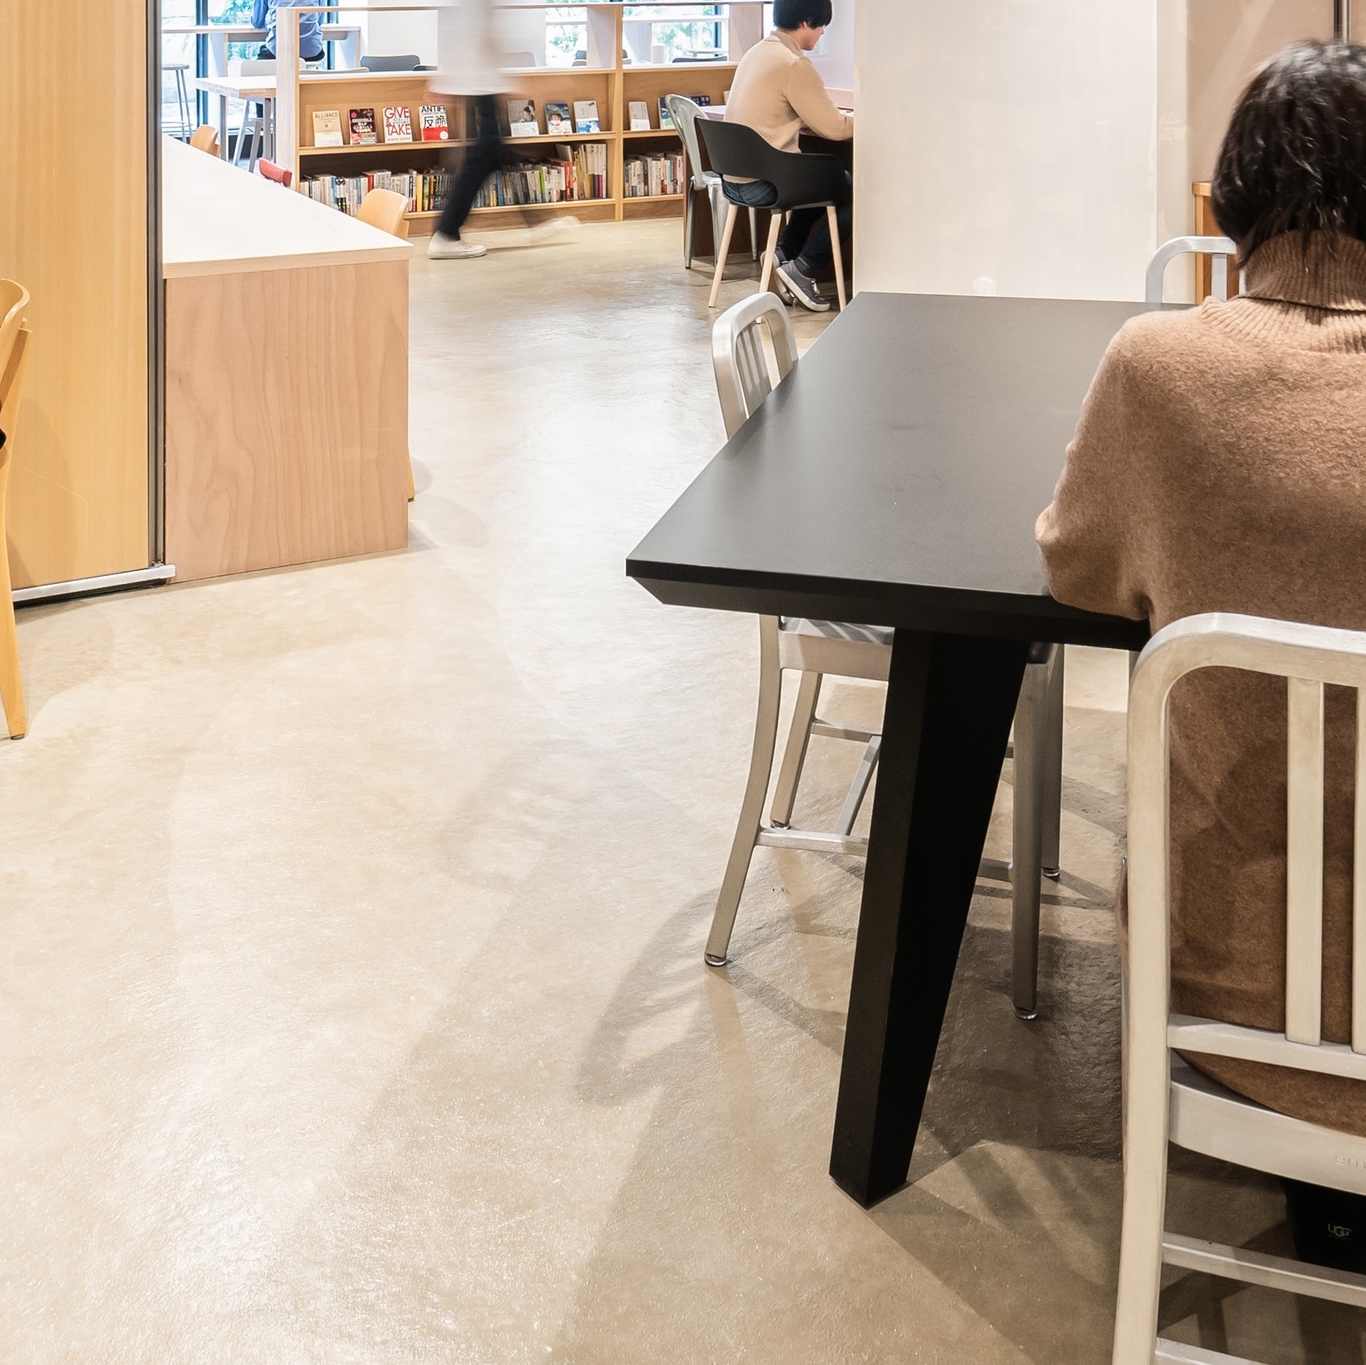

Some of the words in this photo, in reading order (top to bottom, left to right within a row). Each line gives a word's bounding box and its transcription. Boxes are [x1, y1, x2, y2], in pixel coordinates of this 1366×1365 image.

[384, 106, 410, 119] GIVE
[385, 124, 412, 137] TAKE
[1327, 1223, 1352, 1237] UGG
